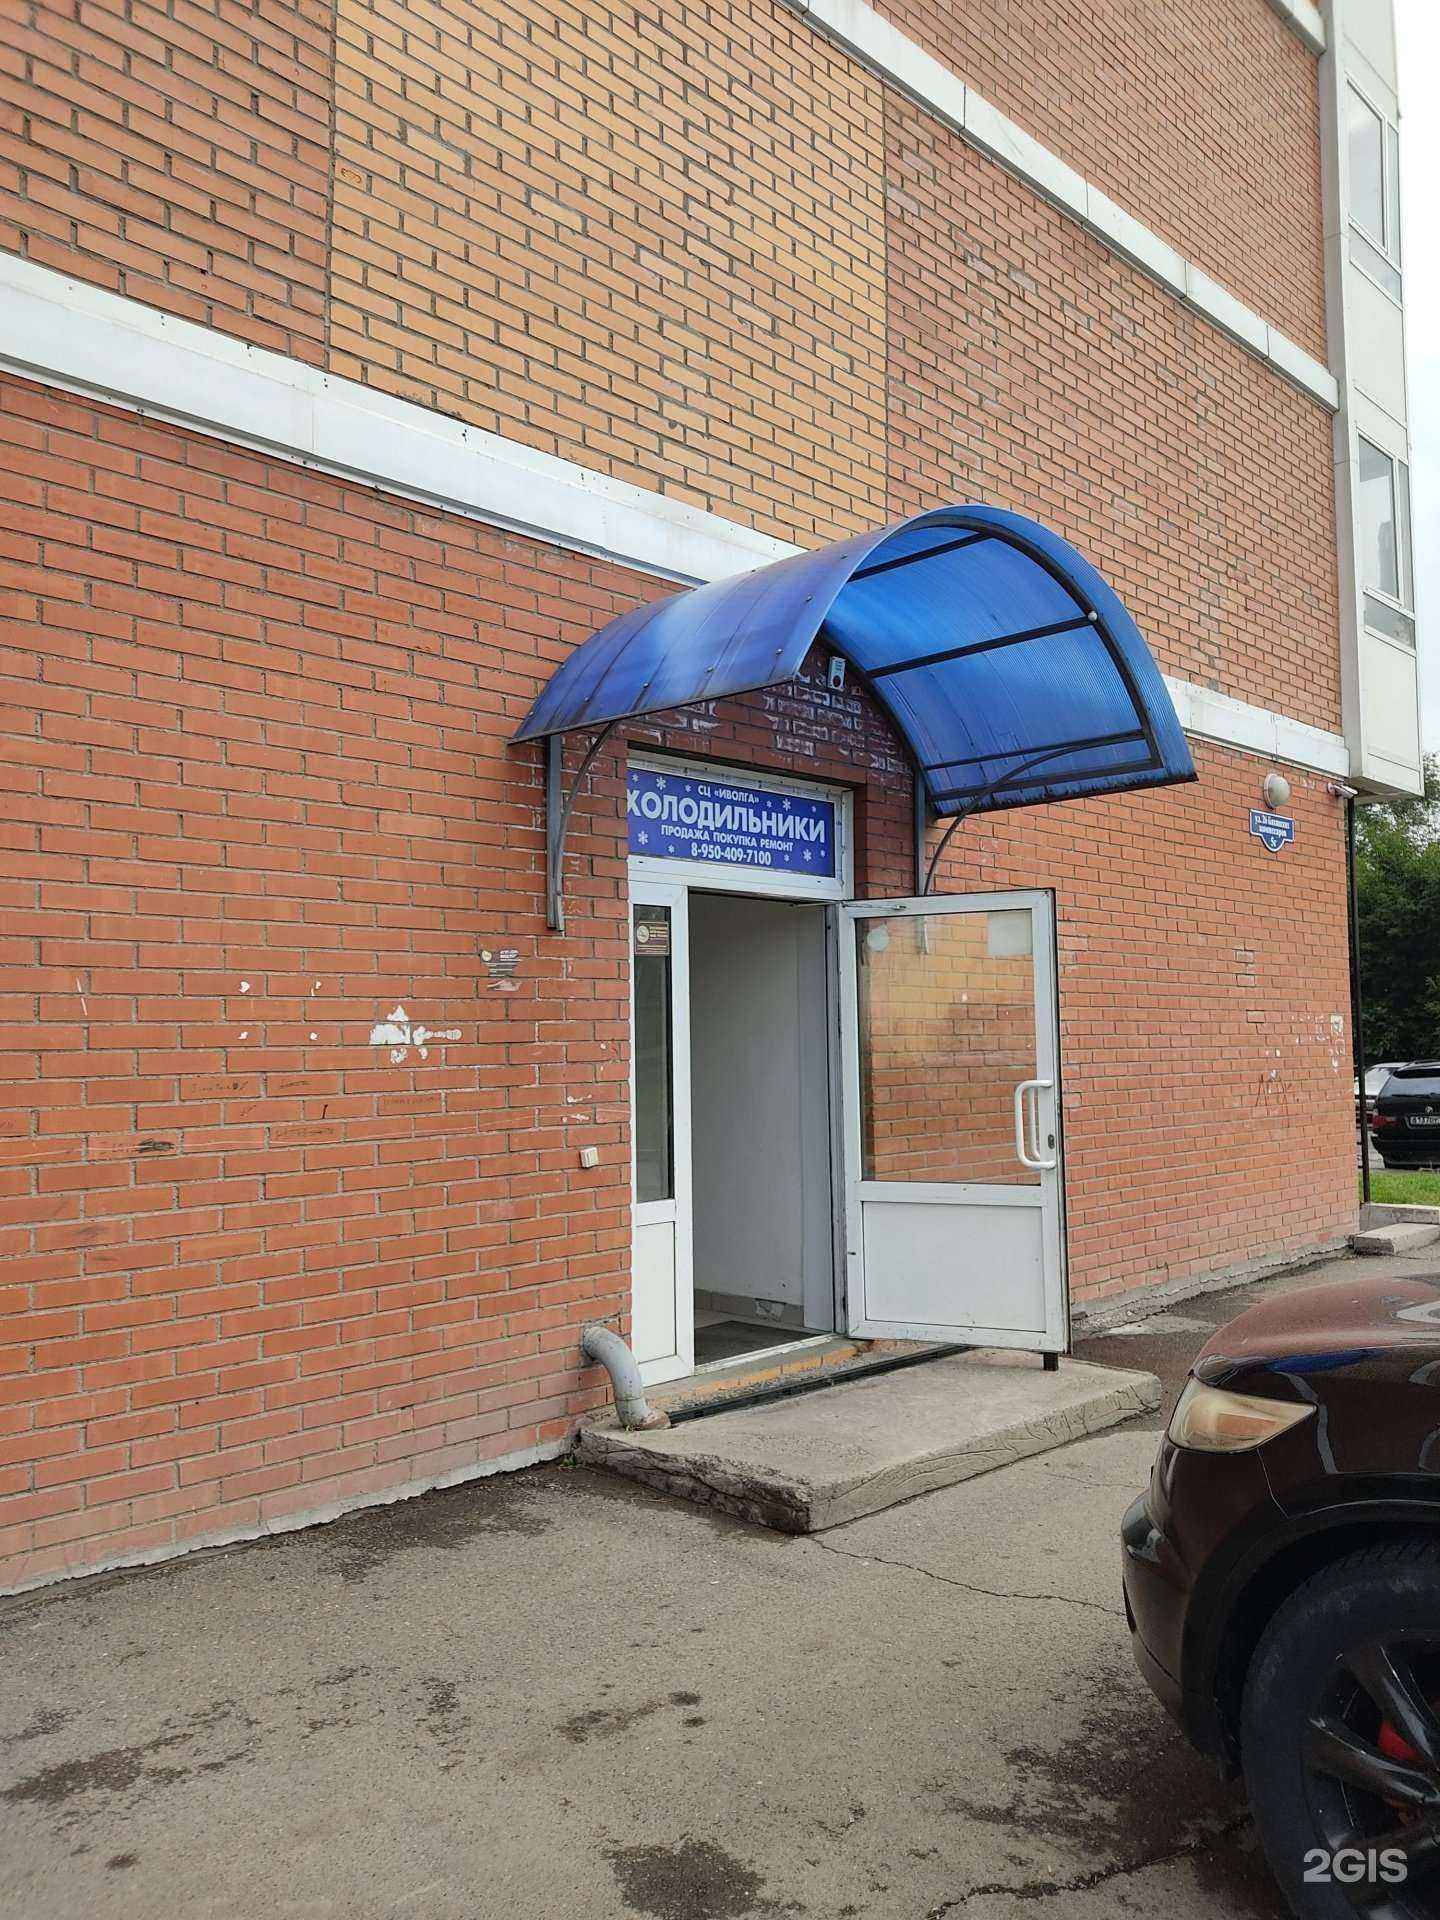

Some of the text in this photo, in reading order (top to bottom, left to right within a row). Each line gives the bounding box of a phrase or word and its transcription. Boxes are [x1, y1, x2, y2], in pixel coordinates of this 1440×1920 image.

[698, 785, 711, 798] СЦ
[627, 788, 825, 844] ХОЛОДИЛЬНИКИ
[661, 824, 793, 852] ПРОДАЖА ПОКУПКА РЕМОНТ
[691, 843, 771, 866] 8-950-409-7100
